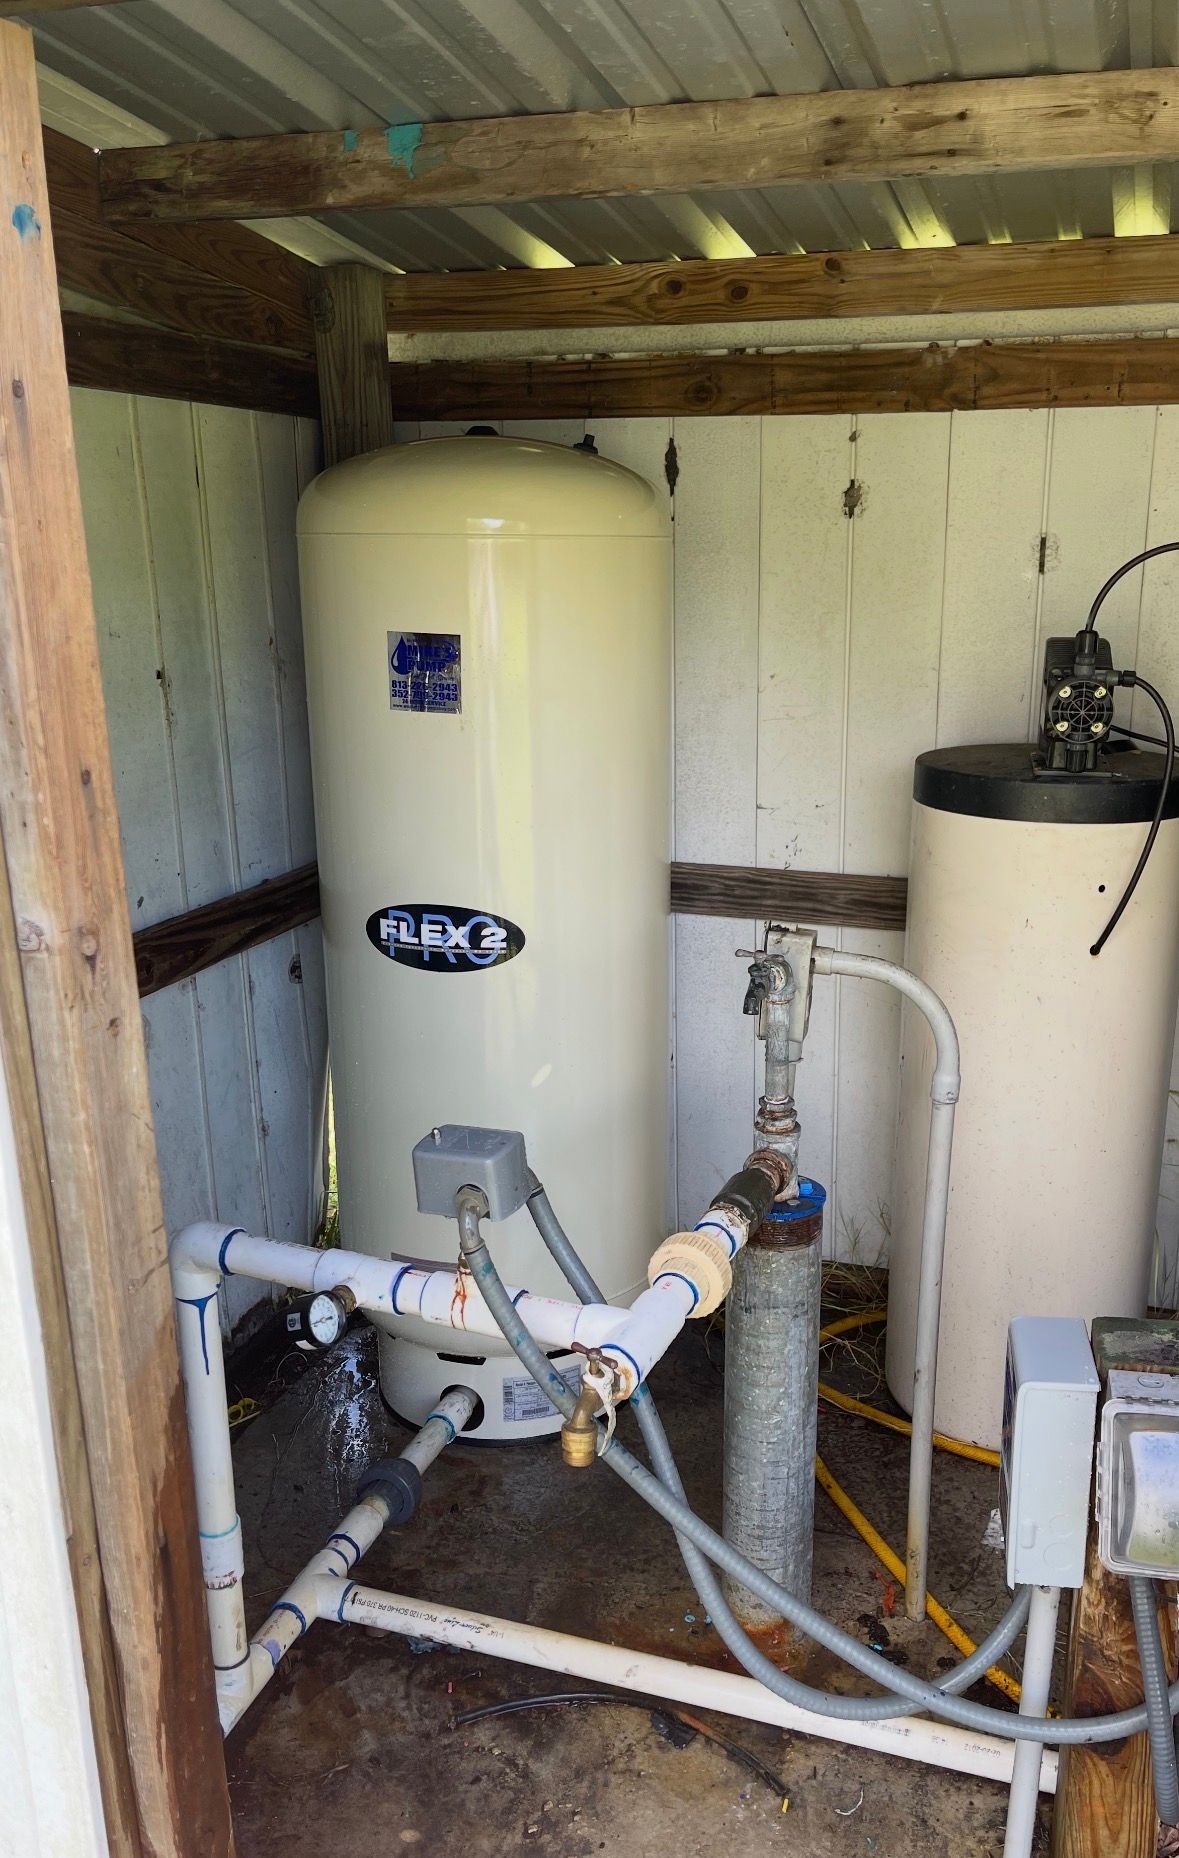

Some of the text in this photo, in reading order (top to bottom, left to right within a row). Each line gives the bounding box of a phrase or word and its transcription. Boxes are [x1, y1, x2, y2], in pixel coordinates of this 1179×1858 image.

[407, 659, 446, 672] PUMP
[379, 918, 471, 948] FLEX
[480, 926, 508, 948] 2
[377, 1603, 387, 1611] PR
[386, 1604, 410, 1616] SCH-40
[409, 1610, 438, 1623] PVC-1120
